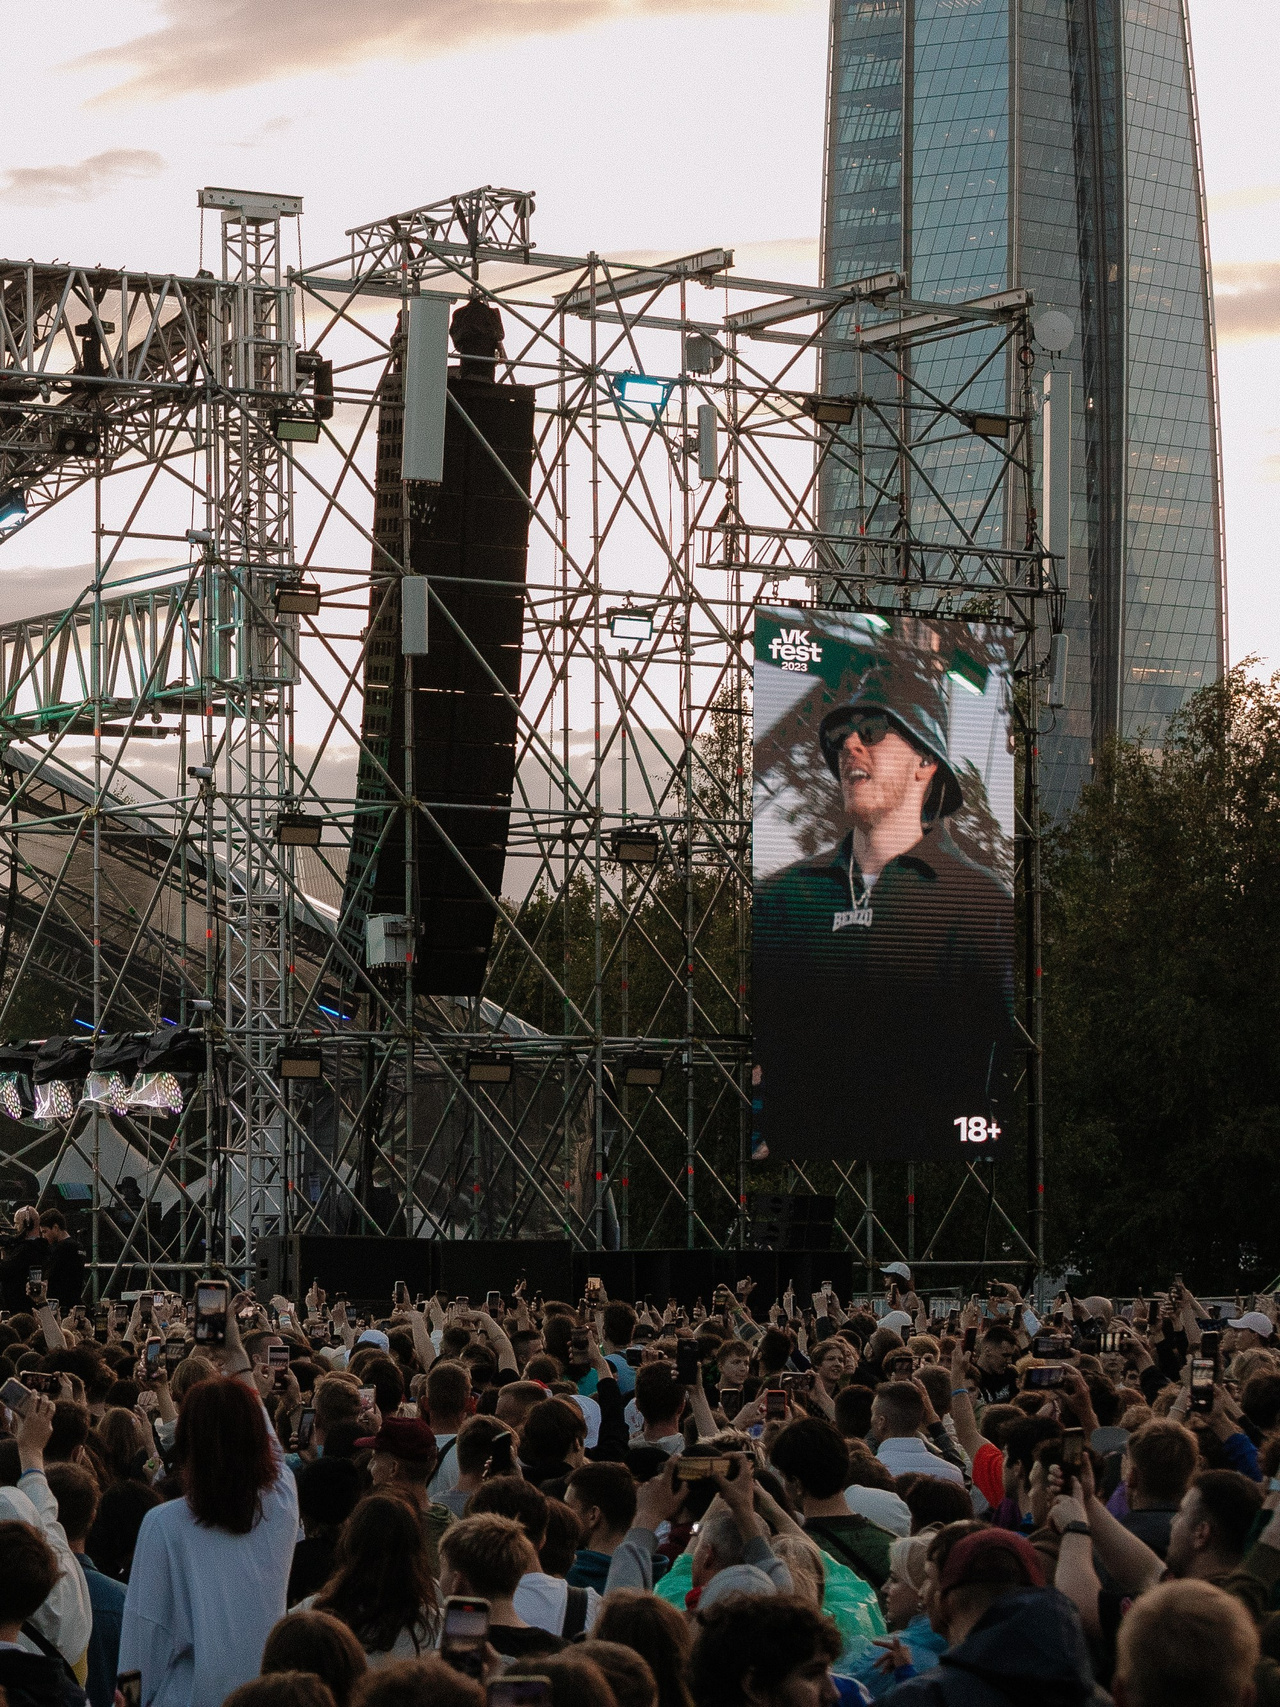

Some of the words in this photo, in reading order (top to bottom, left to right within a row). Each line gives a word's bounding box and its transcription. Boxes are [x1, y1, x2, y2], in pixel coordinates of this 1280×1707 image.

[780, 628, 811, 645] VK
[768, 638, 823, 662] fest
[781, 662, 808, 671] 2023
[953, 1116, 1001, 1142] 18+
